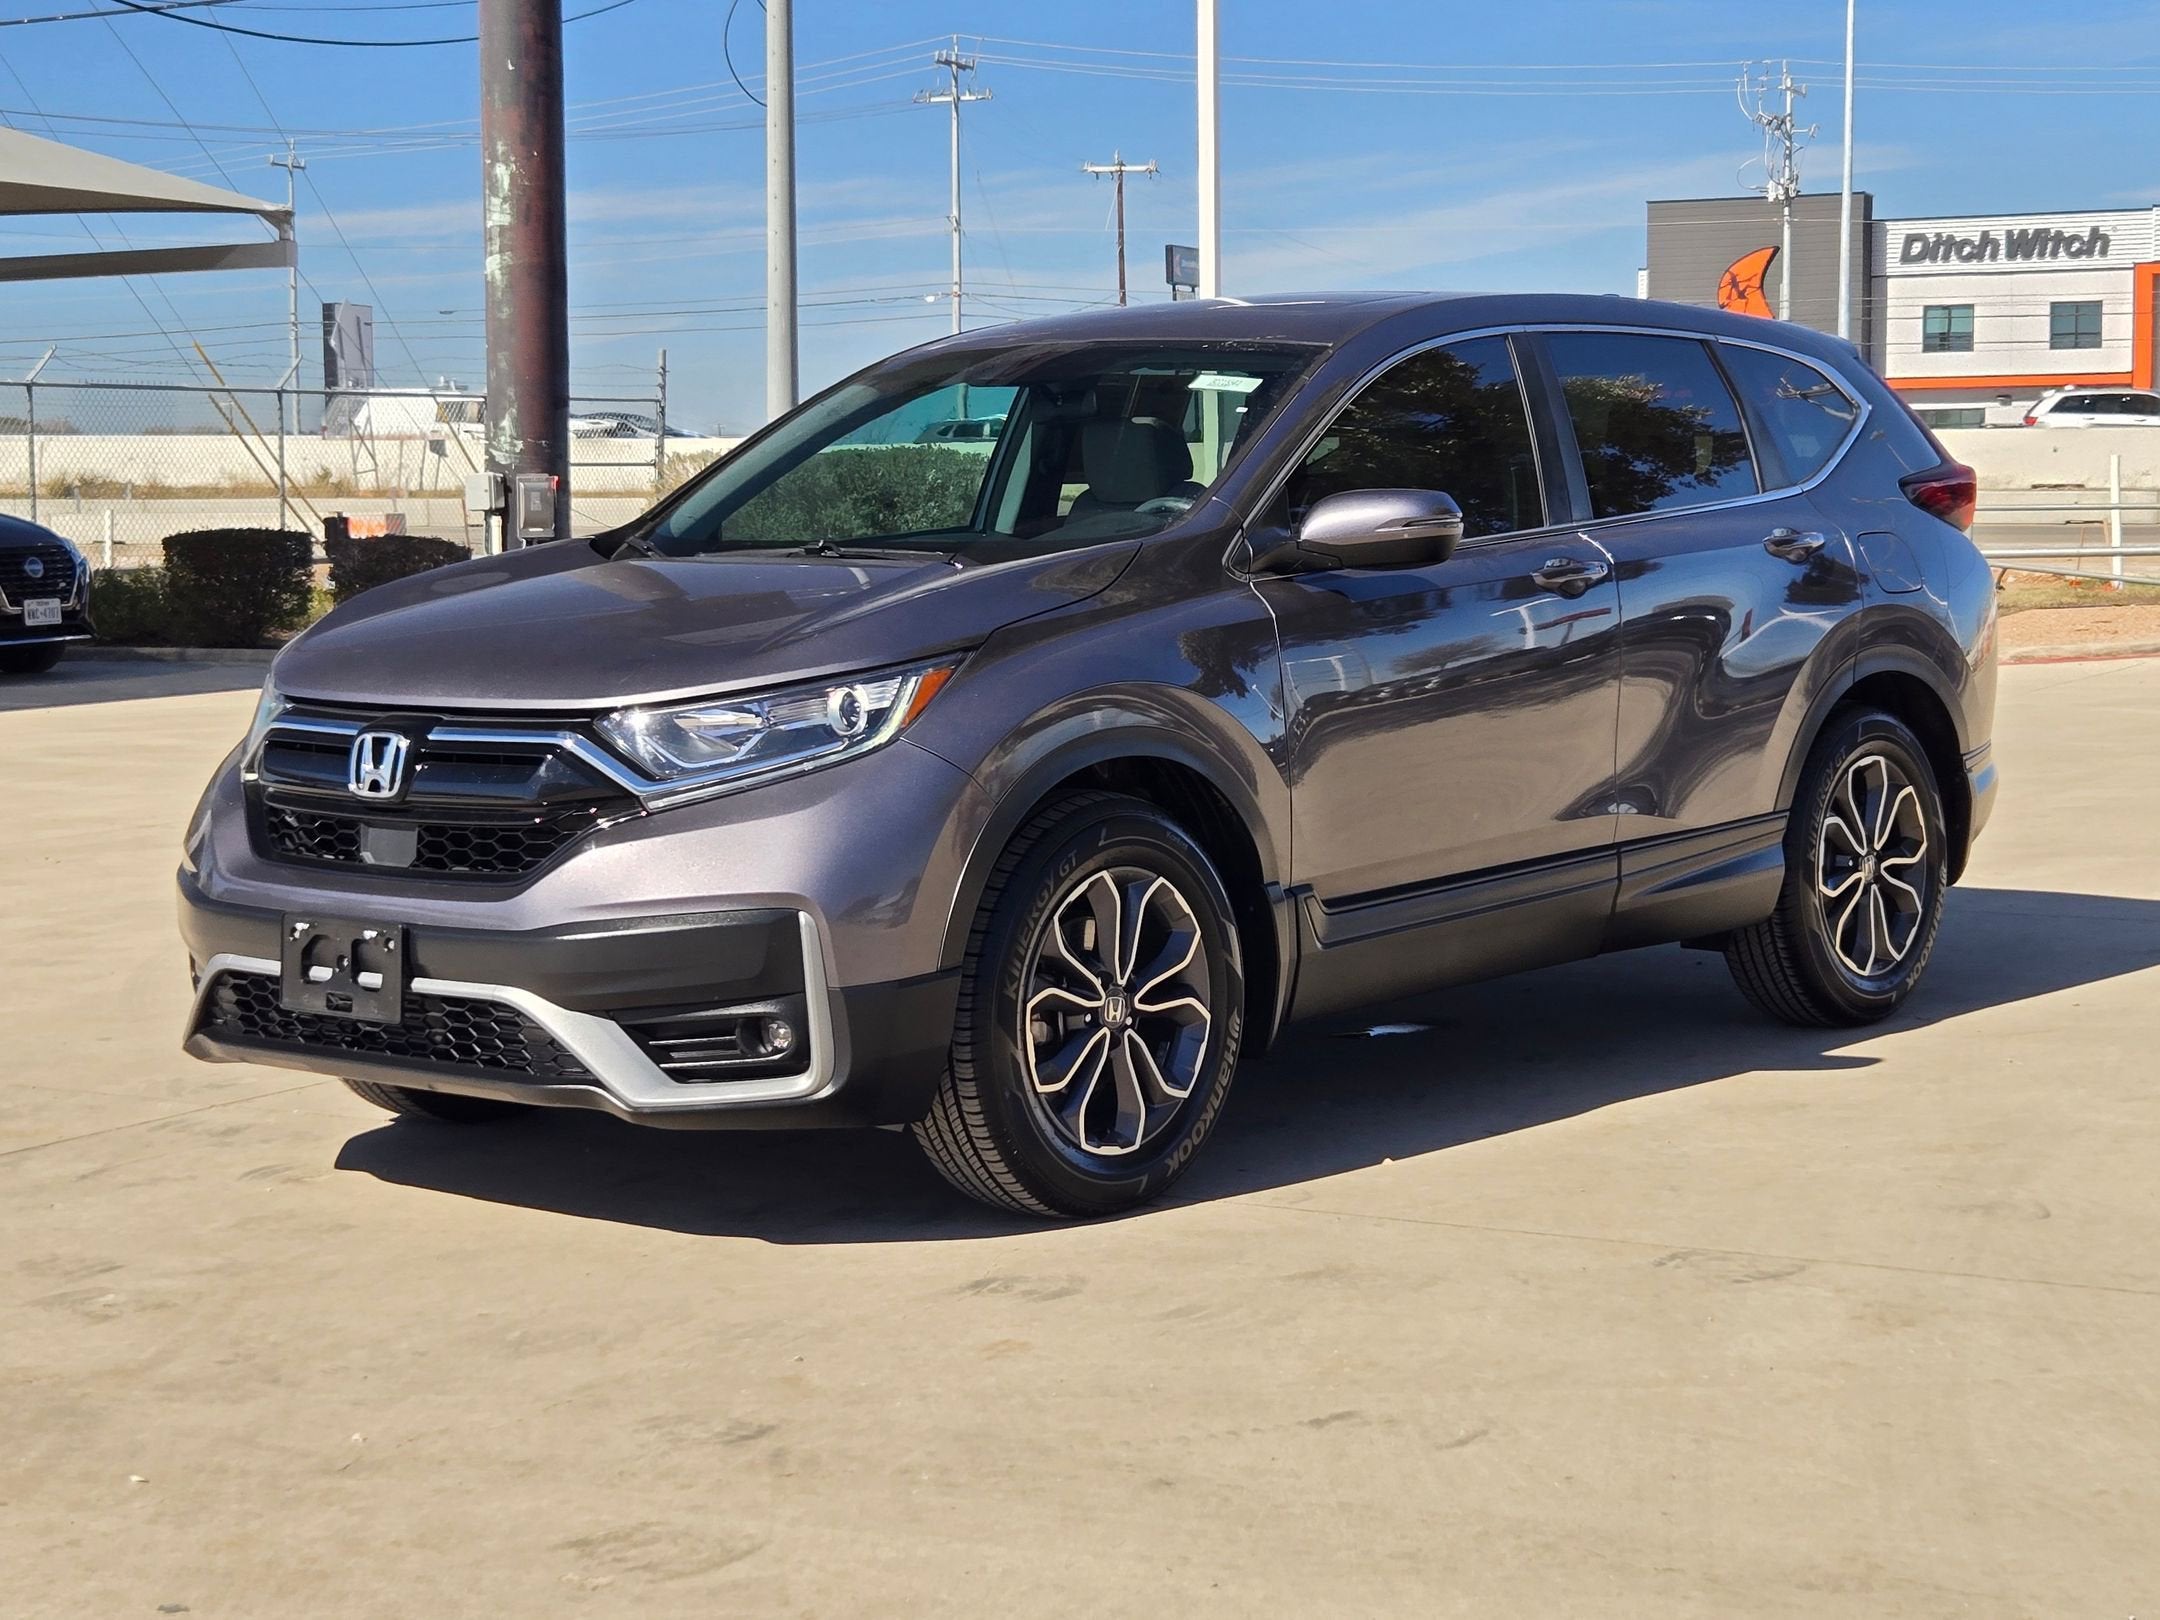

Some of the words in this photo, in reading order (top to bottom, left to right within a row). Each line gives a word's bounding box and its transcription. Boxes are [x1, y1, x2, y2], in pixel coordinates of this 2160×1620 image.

[1899, 230, 2000, 265] Ditch
[2005, 226, 2111, 261] Witch
[1059, 849, 1078, 878] GT
